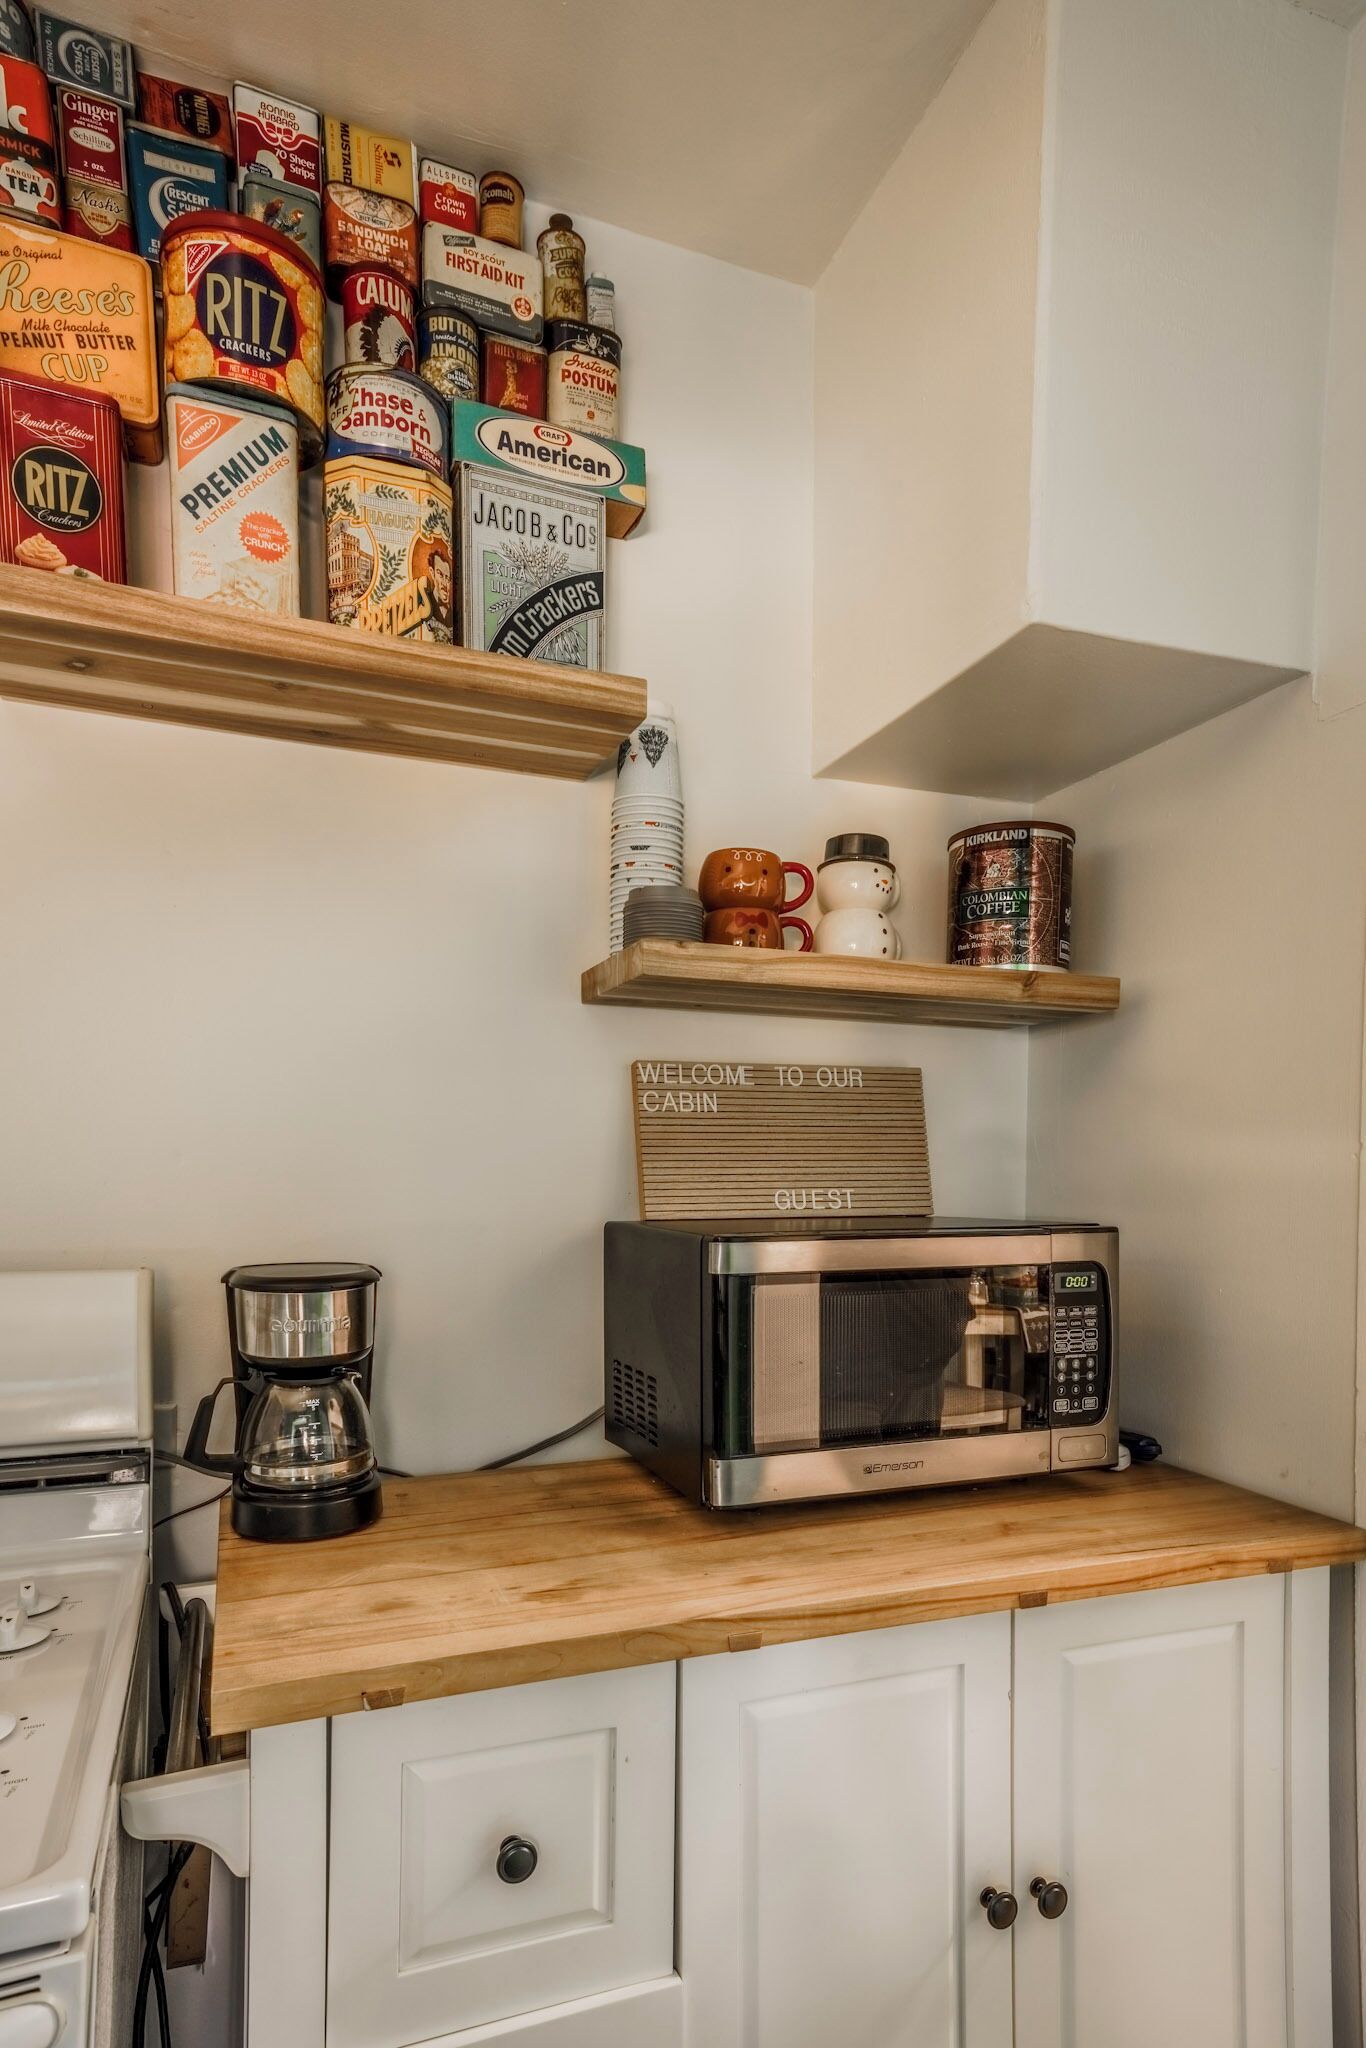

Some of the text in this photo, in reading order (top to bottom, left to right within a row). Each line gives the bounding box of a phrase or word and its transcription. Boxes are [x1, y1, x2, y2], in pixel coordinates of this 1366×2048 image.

[72, 41, 84, 76] SPICES
[114, 50, 122, 87] SAGE
[62, 92, 117, 123] Ginger
[258, 110, 300, 132] HUBBARD
[72, 130, 112, 150] Schilling
[83, 160, 89, 168] 2
[274, 147, 287, 160] 70
[289, 152, 316, 170] Sheer
[340, 122, 352, 186] MUSTARD
[374, 143, 384, 187] Schilling
[5, 166, 41, 182] BANQUET
[289, 163, 316, 180] Strips
[427, 164, 474, 189] ALLSPICE
[6, 174, 42, 198] TEA
[164, 182, 210, 208] CRESCENT
[73, 189, 124, 214] Nash's
[434, 201, 467, 221] Colony
[435, 192, 466, 210] Crown
[338, 219, 410, 251] SANDWICH
[357, 236, 391, 256] LOAF
[12, 245, 63, 263] Original
[190, 246, 209, 271] NABISCO
[463, 247, 506, 268] BOY SCOUT
[445, 251, 525, 290] FIRST AID KIT
[0, 259, 136, 316] Reese's
[20, 318, 111, 333] Milk Chocolate
[206, 272, 288, 358] RITZ
[429, 316, 474, 343] BUTTER
[1, 331, 137, 351] PEANUT BUTTER
[219, 338, 272, 363] CRACKERS
[41, 353, 108, 382] CUP
[565, 354, 617, 380] Instant
[561, 367, 617, 398] POSTUM
[331, 405, 348, 421] OFF
[418, 408, 427, 423] &
[13, 410, 95, 441] Limited Edition
[183, 417, 217, 447] NABISCO
[541, 430, 566, 442] KRAFT
[362, 430, 409, 445] COFFEE
[416, 444, 441, 466] REGULAR
[497, 430, 610, 478] American
[180, 425, 289, 520] PREMIUM
[25, 459, 89, 518] RITZ
[195, 455, 290, 534] SALTINE CRACKERS
[36, 507, 82, 528] Crackers
[475, 494, 541, 538] JACOB
[547, 524, 558, 543] &
[258, 532, 272, 540] with
[260, 526, 283, 537] cracker
[244, 536, 285, 553] CRUNCH
[487, 561, 528, 582] EXTRA
[491, 580, 524, 598] LIGHT
[359, 576, 432, 635] PRETZELS
[513, 580, 600, 640] Crackers
[966, 829, 1028, 847] KIRKLAND
[962, 891, 1028, 906] COLOMBIAN
[967, 901, 1020, 919] COFFEE
[638, 1063, 863, 1087] WELCOME TO OUR
[643, 1091, 717, 1113] CABIN
[775, 1189, 854, 1210] GUEST
[1066, 1277, 1088, 1288] 0:00
[873, 1461, 924, 1472] Emerson
